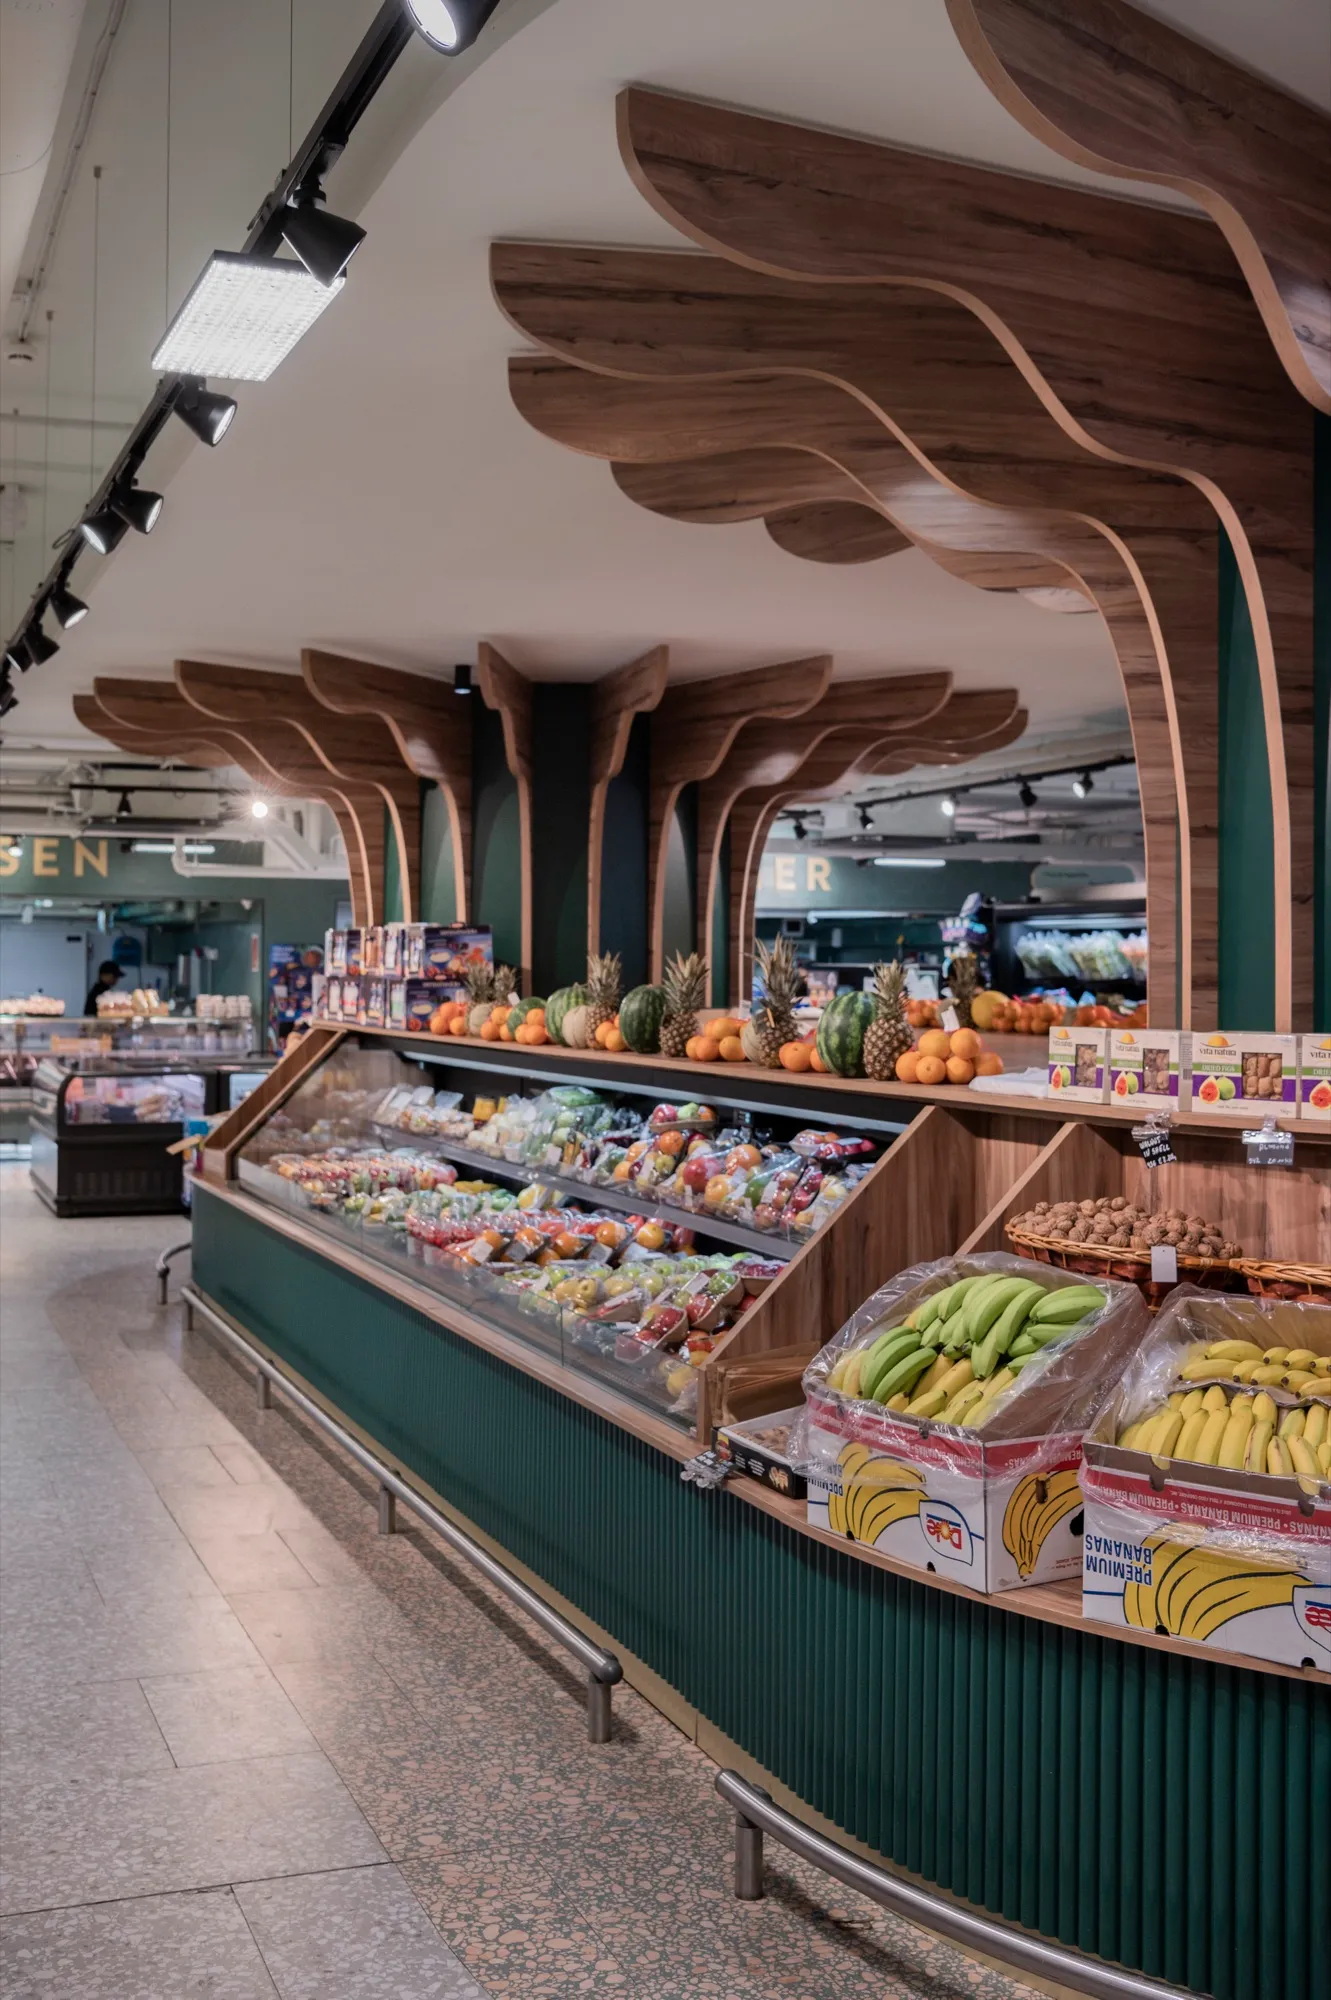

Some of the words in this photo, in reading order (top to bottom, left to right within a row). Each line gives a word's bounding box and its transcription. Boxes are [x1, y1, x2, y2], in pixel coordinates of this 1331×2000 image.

[757, 856, 832, 891] ER
[1129, 1492, 1174, 1510] PREMIUM
[1180, 1503, 1229, 1522] BANANAS
[926, 1518, 962, 1550] Dole
[1231, 1511, 1281, 1529] PREMIUM
[1085, 1534, 1152, 1565] BANANAS
[1086, 1554, 1152, 1586] PREMIUM
